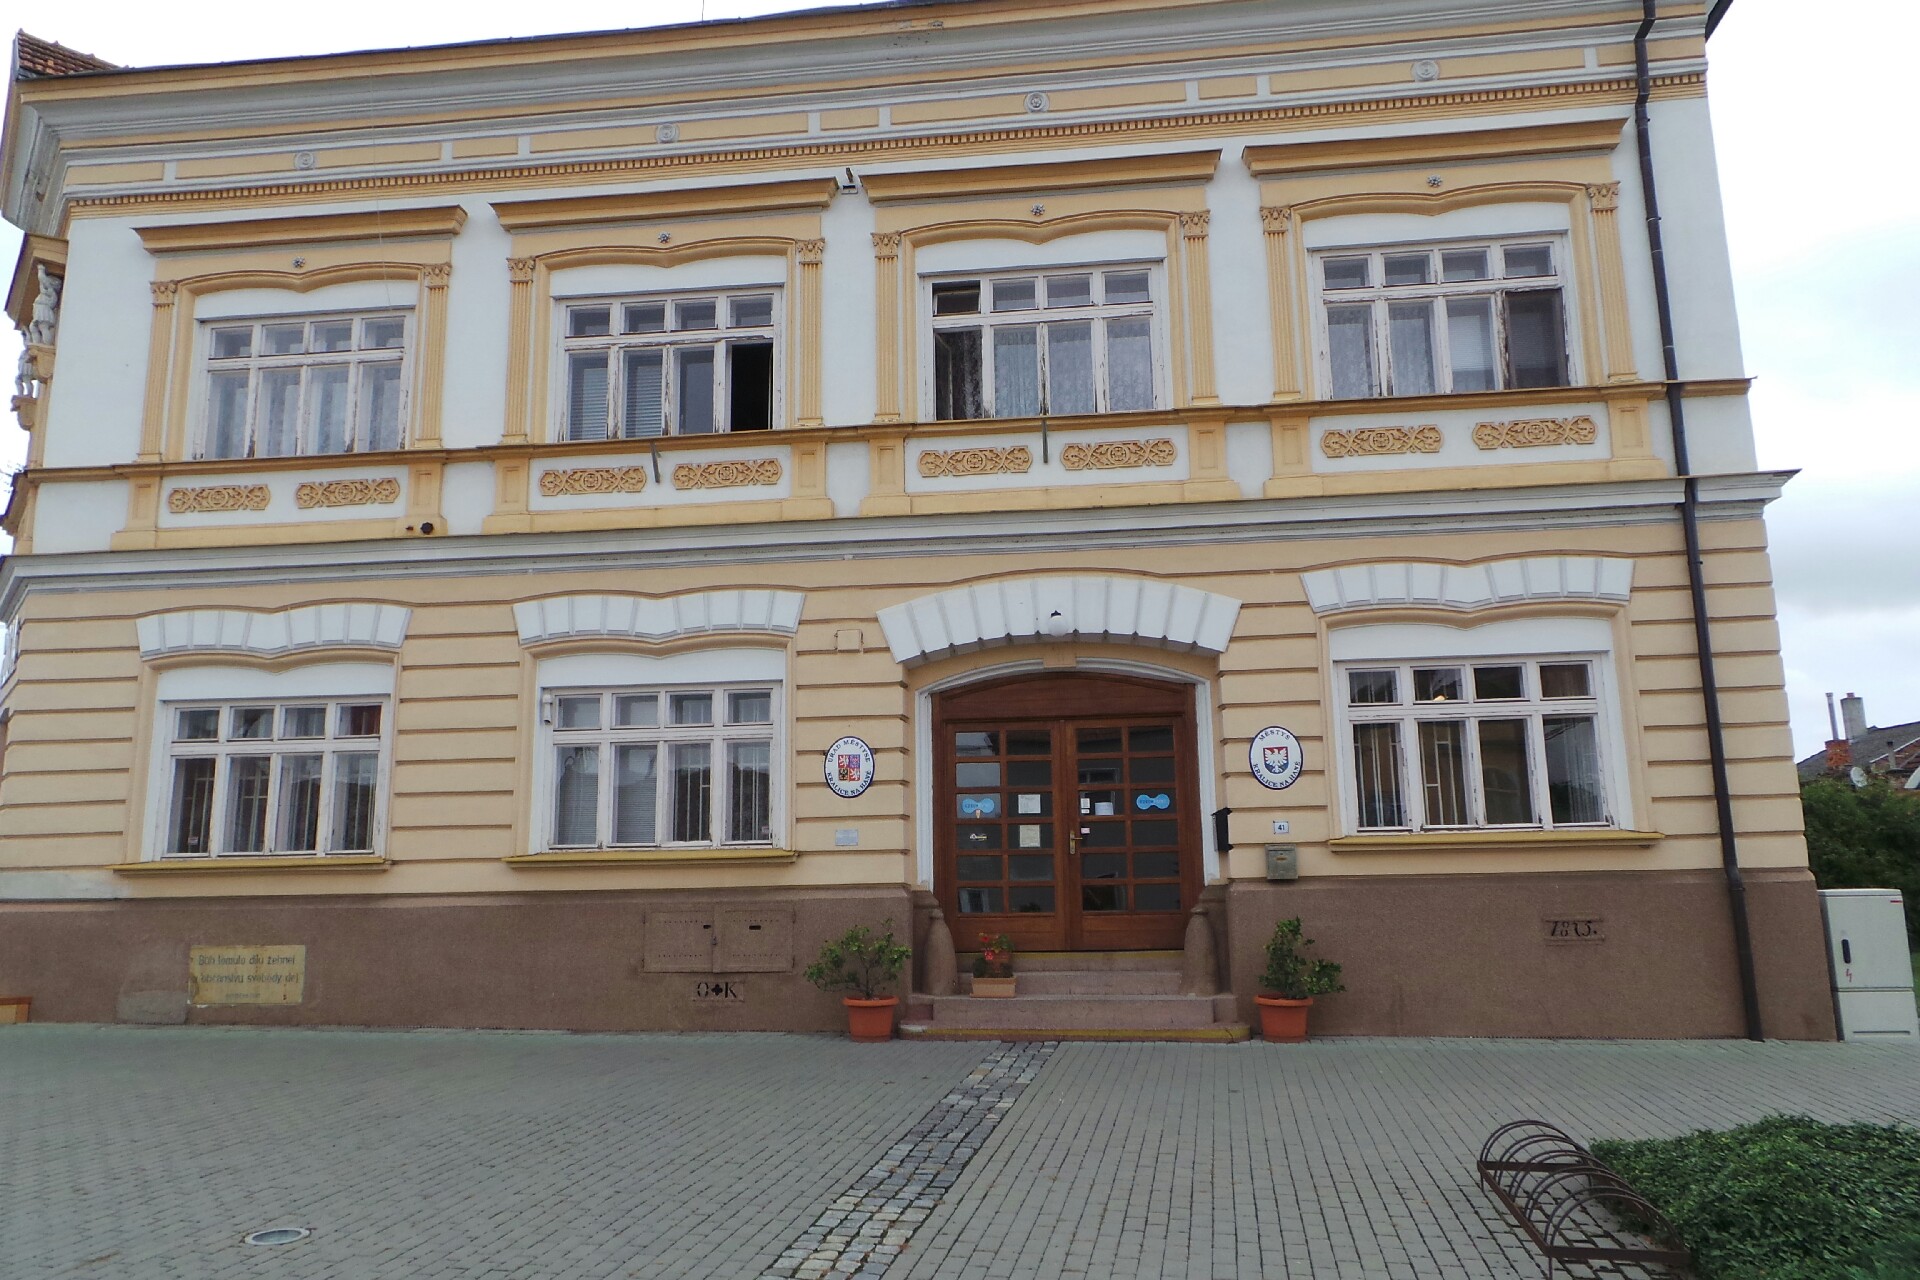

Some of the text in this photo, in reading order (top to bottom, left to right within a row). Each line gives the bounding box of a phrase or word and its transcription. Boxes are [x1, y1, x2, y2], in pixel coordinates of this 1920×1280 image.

[827, 772, 849, 796] KRALICE
[850, 788, 861, 796] NA
[1253, 763, 1278, 788] KRALICE
[1279, 779, 1290, 788] NA
